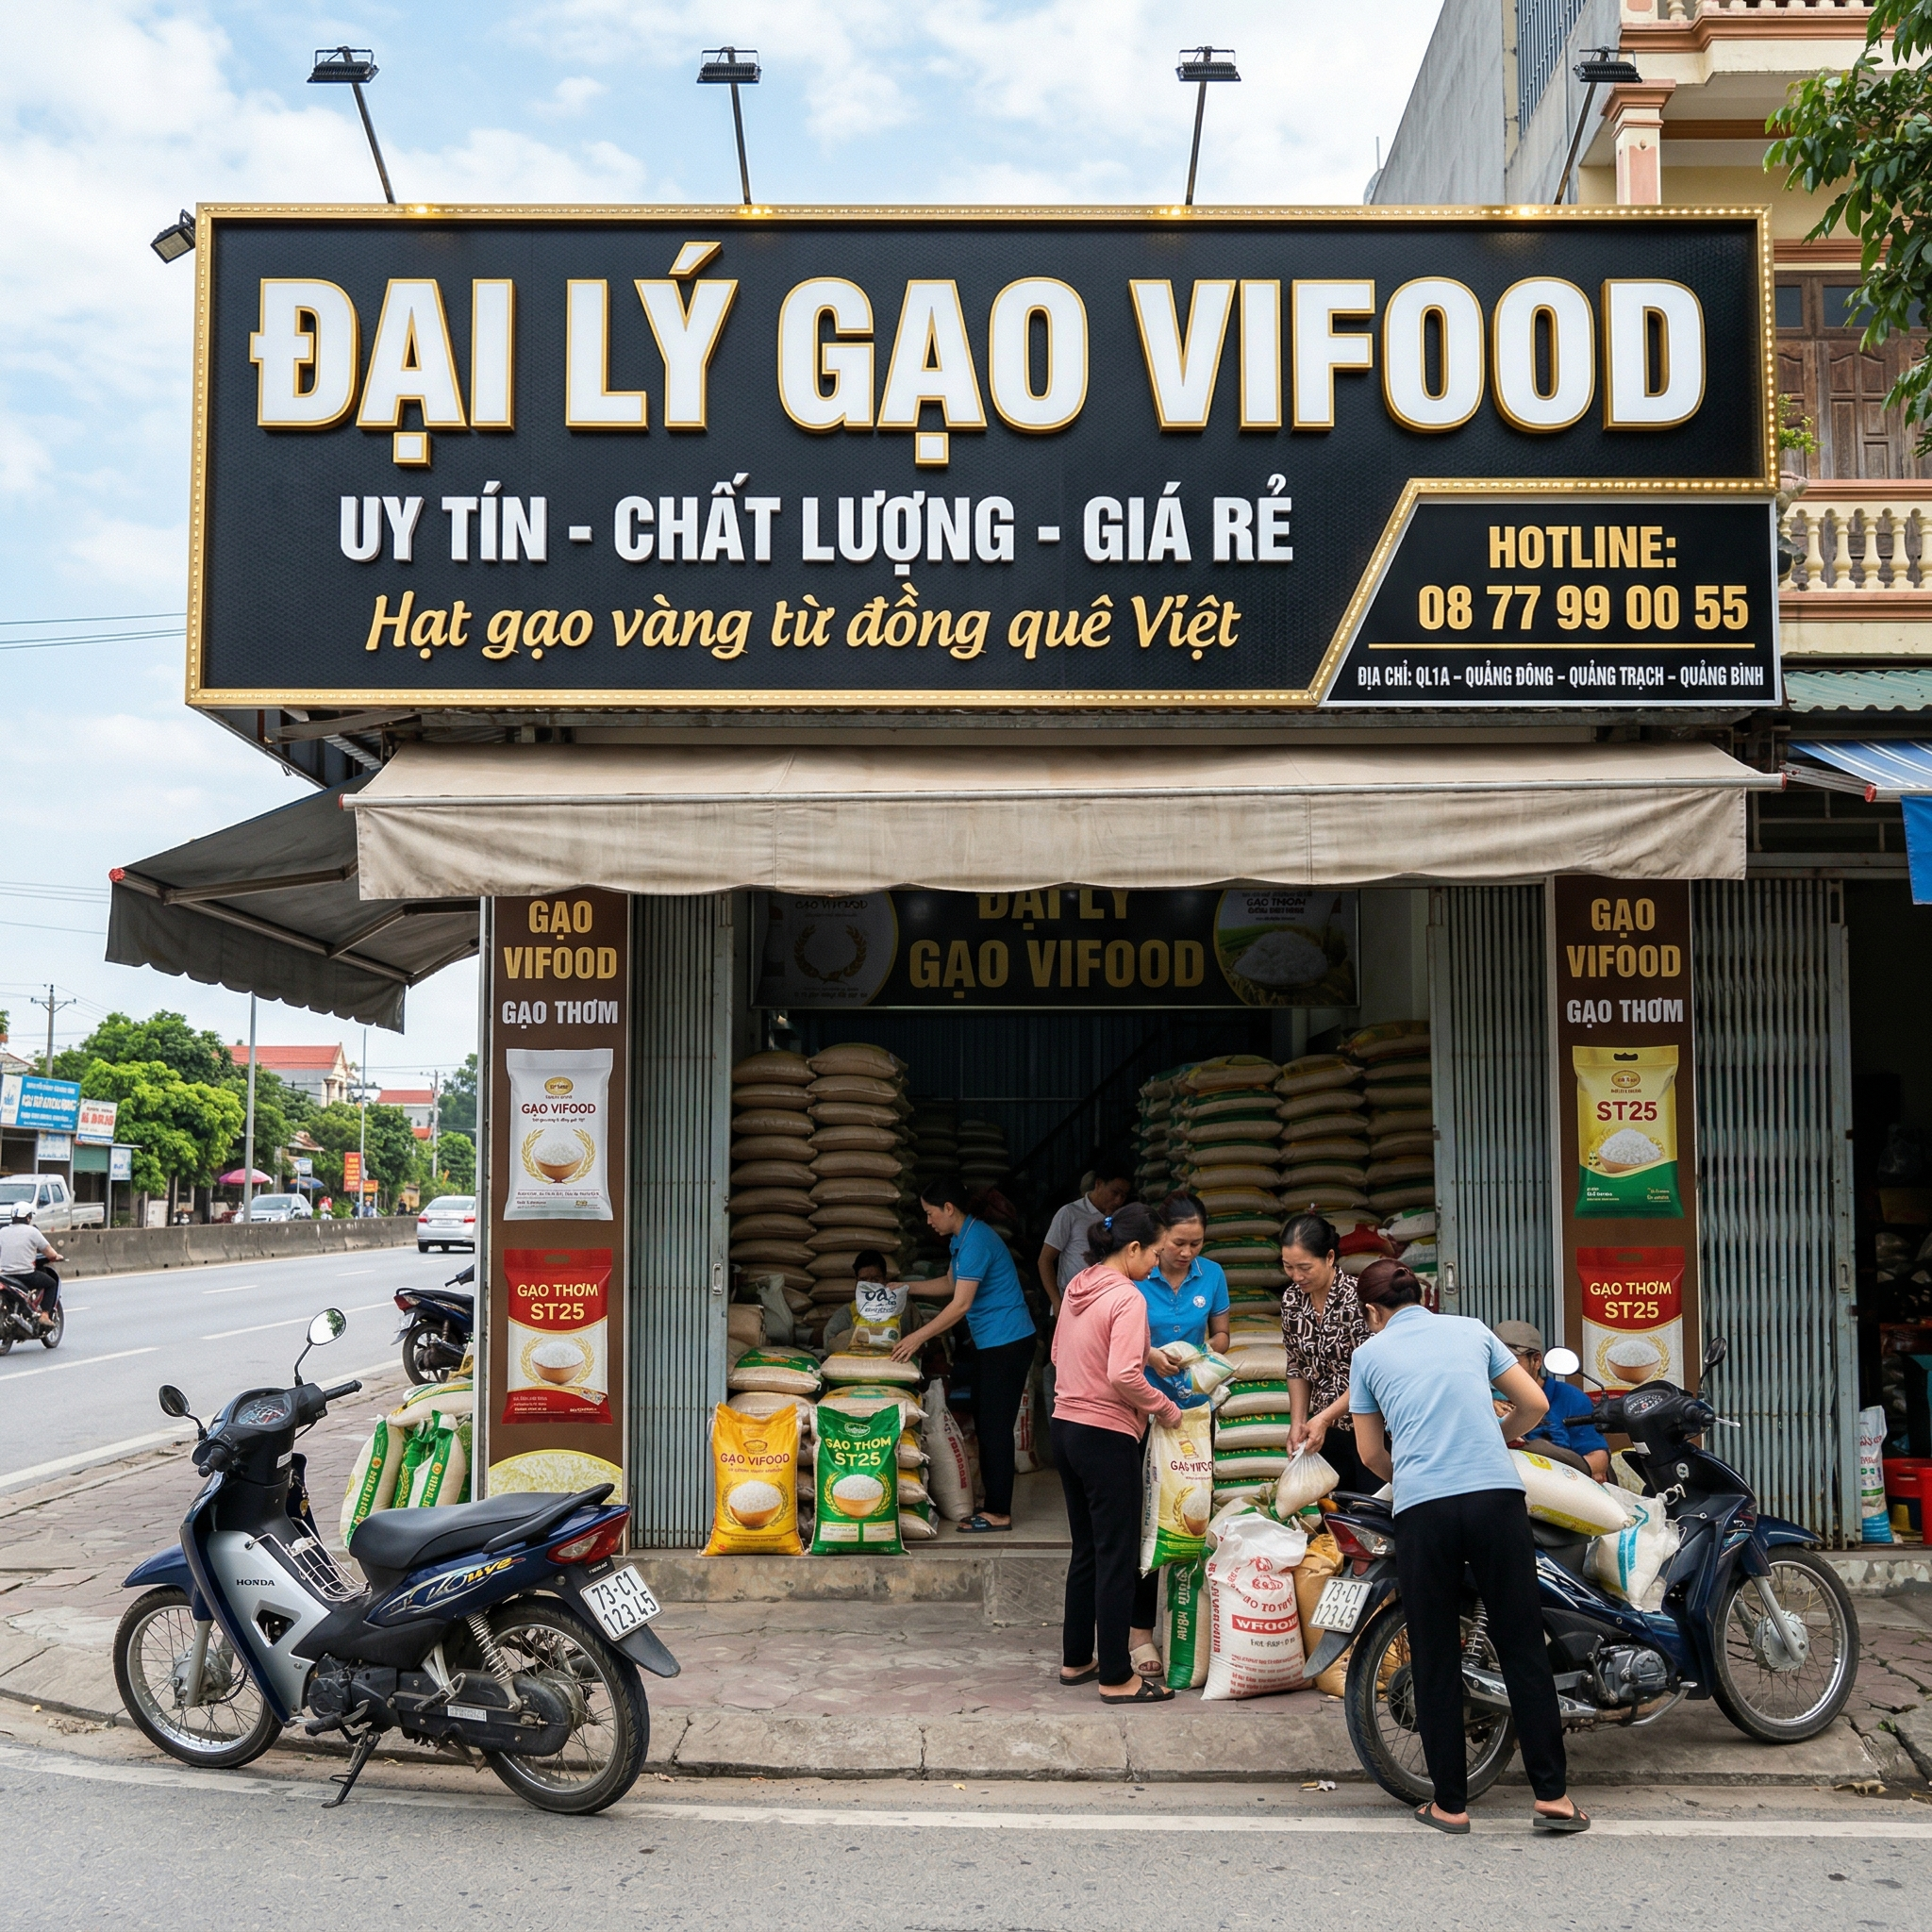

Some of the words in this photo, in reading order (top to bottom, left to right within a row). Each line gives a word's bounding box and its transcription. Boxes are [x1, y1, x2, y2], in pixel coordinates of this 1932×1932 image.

[249, 278, 515, 467] ĐẠI
[566, 242, 739, 431] LÝ
[777, 276, 1089, 467] GẠO
[1129, 275, 1707, 433] VIFOOD
[340, 495, 425, 562] UY
[441, 480, 548, 562] TÍN
[614, 473, 781, 562] CHẤT
[802, 490, 1015, 576] LƯỢNG
[1083, 481, 1191, 562] GIÁ
[1213, 474, 1293, 562] RẺ
[1488, 525, 1676, 569] HOTLINE:
[365, 591, 472, 659] Hạt
[482, 608, 594, 660] gạo
[611, 593, 753, 660] vàng
[771, 593, 836, 648] từ
[846, 582, 991, 660] đồng
[1008, 594, 1114, 660] quê
[1131, 594, 1241, 660] Việt
[1418, 584, 1473, 630] 08
[1486, 584, 1541, 630] 77
[1557, 584, 1610, 630] 99
[1625, 584, 1679, 630] 00
[1694, 584, 1749, 630] 55
[1357, 666, 1381, 691] ĐỊA
[1385, 659, 1412, 687] CHỈ:
[1415, 666, 1451, 689] QL1A
[1465, 659, 1512, 689] QUẢNG
[1515, 662, 1554, 687] ĐÔNG
[1569, 659, 1616, 689] QUẢNG
[1619, 666, 1664, 691] TRẠCH
[1679, 659, 1727, 689] QUẢNG
[528, 900, 593, 941] GẠO
[1591, 898, 1656, 939] GẠO
[503, 946, 617, 980] VIFOOD
[908, 940, 1008, 999] GẠO
[1026, 940, 1205, 988] VIFOOD
[1566, 944, 1681, 978] VIFOOD
[502, 1000, 547, 1029] GẠO
[555, 998, 619, 1024] THƠM
[1567, 999, 1612, 1028] GẠO
[1619, 997, 1684, 1023] THƠM
[521, 1103, 548, 1117] GẠO
[552, 1102, 596, 1115] VIFOOD
[1596, 1101, 1657, 1122] ST25
[517, 1284, 549, 1301] GẠO
[553, 1282, 598, 1297] THƠM
[1590, 1282, 1623, 1299] GẠO
[1625, 1281, 1672, 1295] THƠM
[530, 1303, 585, 1321] ST25
[1605, 1301, 1659, 1319] ST25
[720, 1453, 745, 1466] GẠO
[748, 1453, 791, 1466] VIFOOD
[835, 1451, 881, 1467] ST25
[236, 1578, 275, 1587] HONDA
